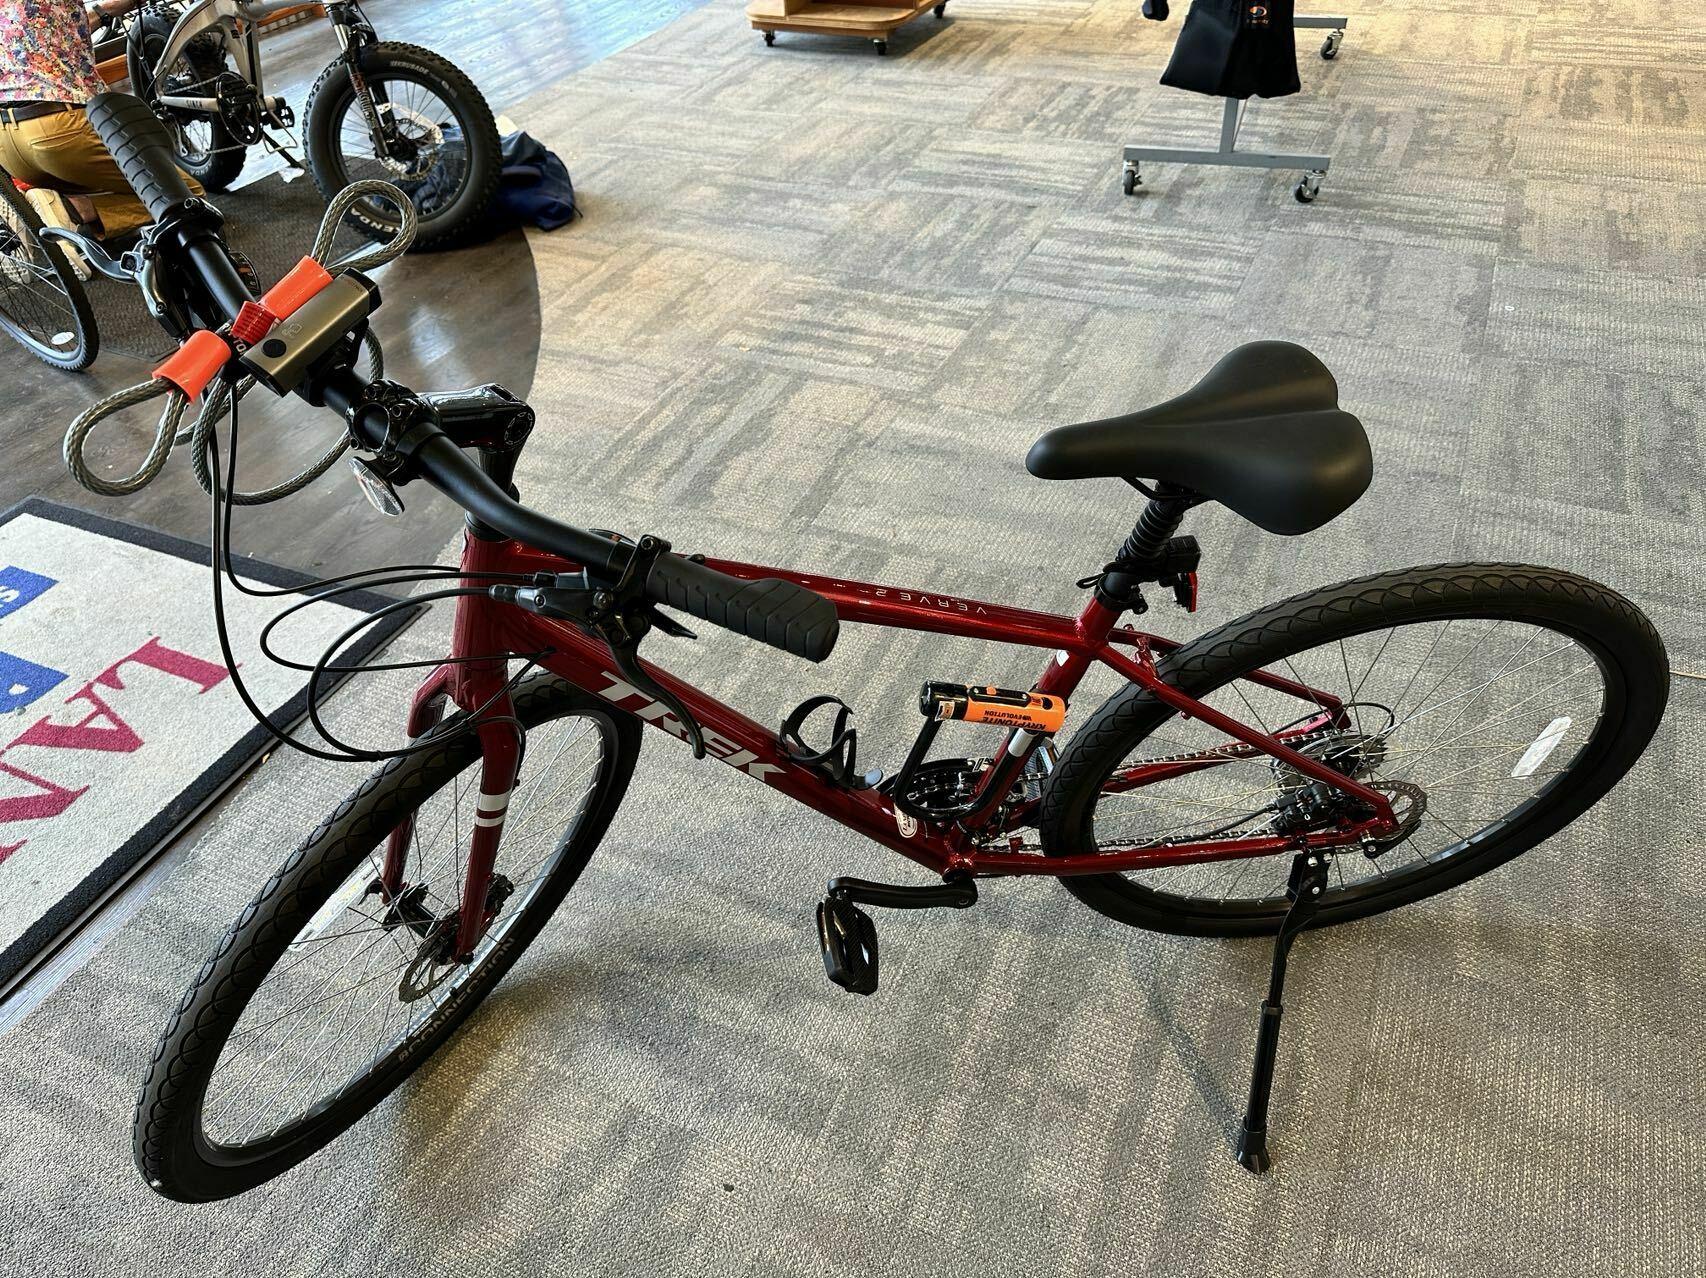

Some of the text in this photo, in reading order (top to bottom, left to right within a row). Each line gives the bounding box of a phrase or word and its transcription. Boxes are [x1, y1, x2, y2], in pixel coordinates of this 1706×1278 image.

[874, 587, 987, 616] VERVE 2
[596, 670, 787, 782] TREK
[981, 715, 1047, 731] KRYPTONITE
[408, 936, 517, 1053] CONNECTION
